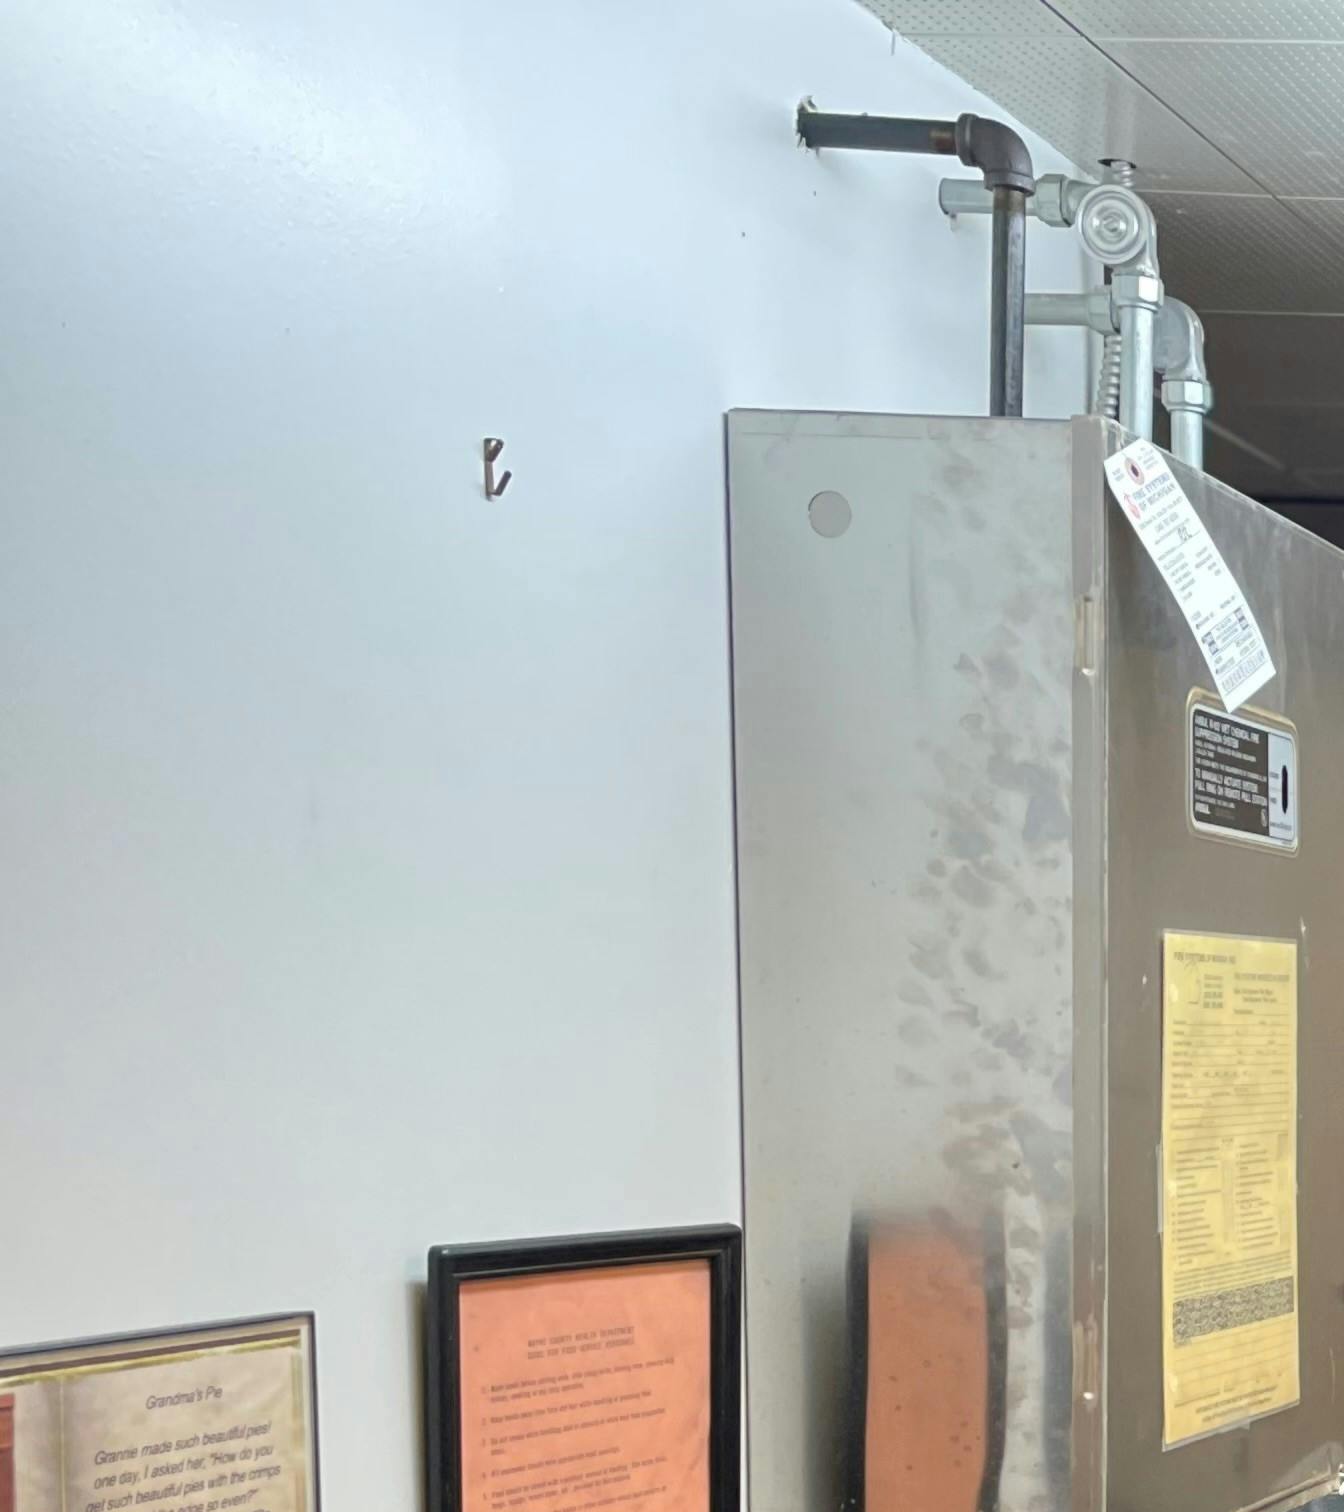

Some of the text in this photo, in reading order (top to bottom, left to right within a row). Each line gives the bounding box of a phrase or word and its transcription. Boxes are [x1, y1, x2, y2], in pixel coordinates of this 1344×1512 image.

[146, 1385, 222, 1410] Grandma's Pie
[141, 1441, 172, 1456] made
[174, 1434, 200, 1451] such
[202, 1426, 246, 1445] beautiful
[94, 1475, 116, 1490] one
[150, 1459, 184, 1478] asked
[239, 1446, 252, 1461] do
[254, 1445, 273, 1460] you
[107, 1494, 133, 1510] such
[135, 1483, 181, 1504] beautiful
[183, 1480, 204, 1497] pies
[208, 1474, 228, 1488] with
[230, 1472, 247, 1484] the
[206, 1500, 218, 1512] so
